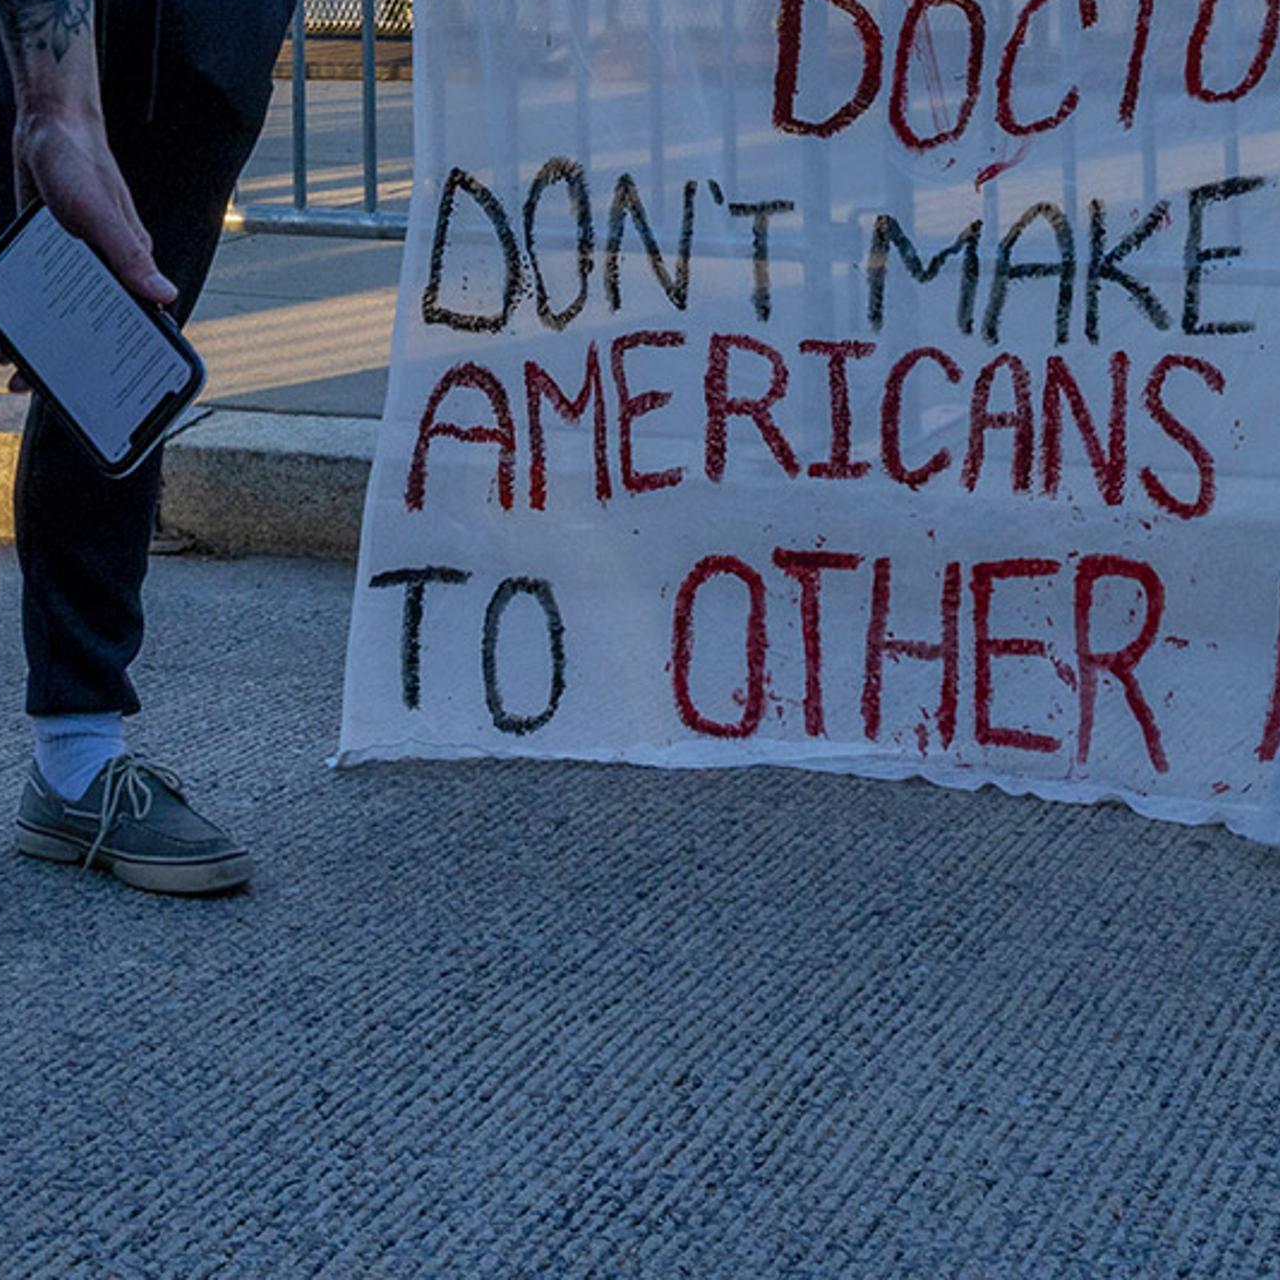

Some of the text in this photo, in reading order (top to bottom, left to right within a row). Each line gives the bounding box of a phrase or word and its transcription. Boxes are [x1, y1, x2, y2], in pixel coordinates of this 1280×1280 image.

[422, 157, 794, 333] DON'T
[867, 175, 1265, 345] MAKE
[405, 329, 1226, 521] AMERICANS
[368, 565, 567, 736] TO
[669, 546, 1170, 774] OTHER
